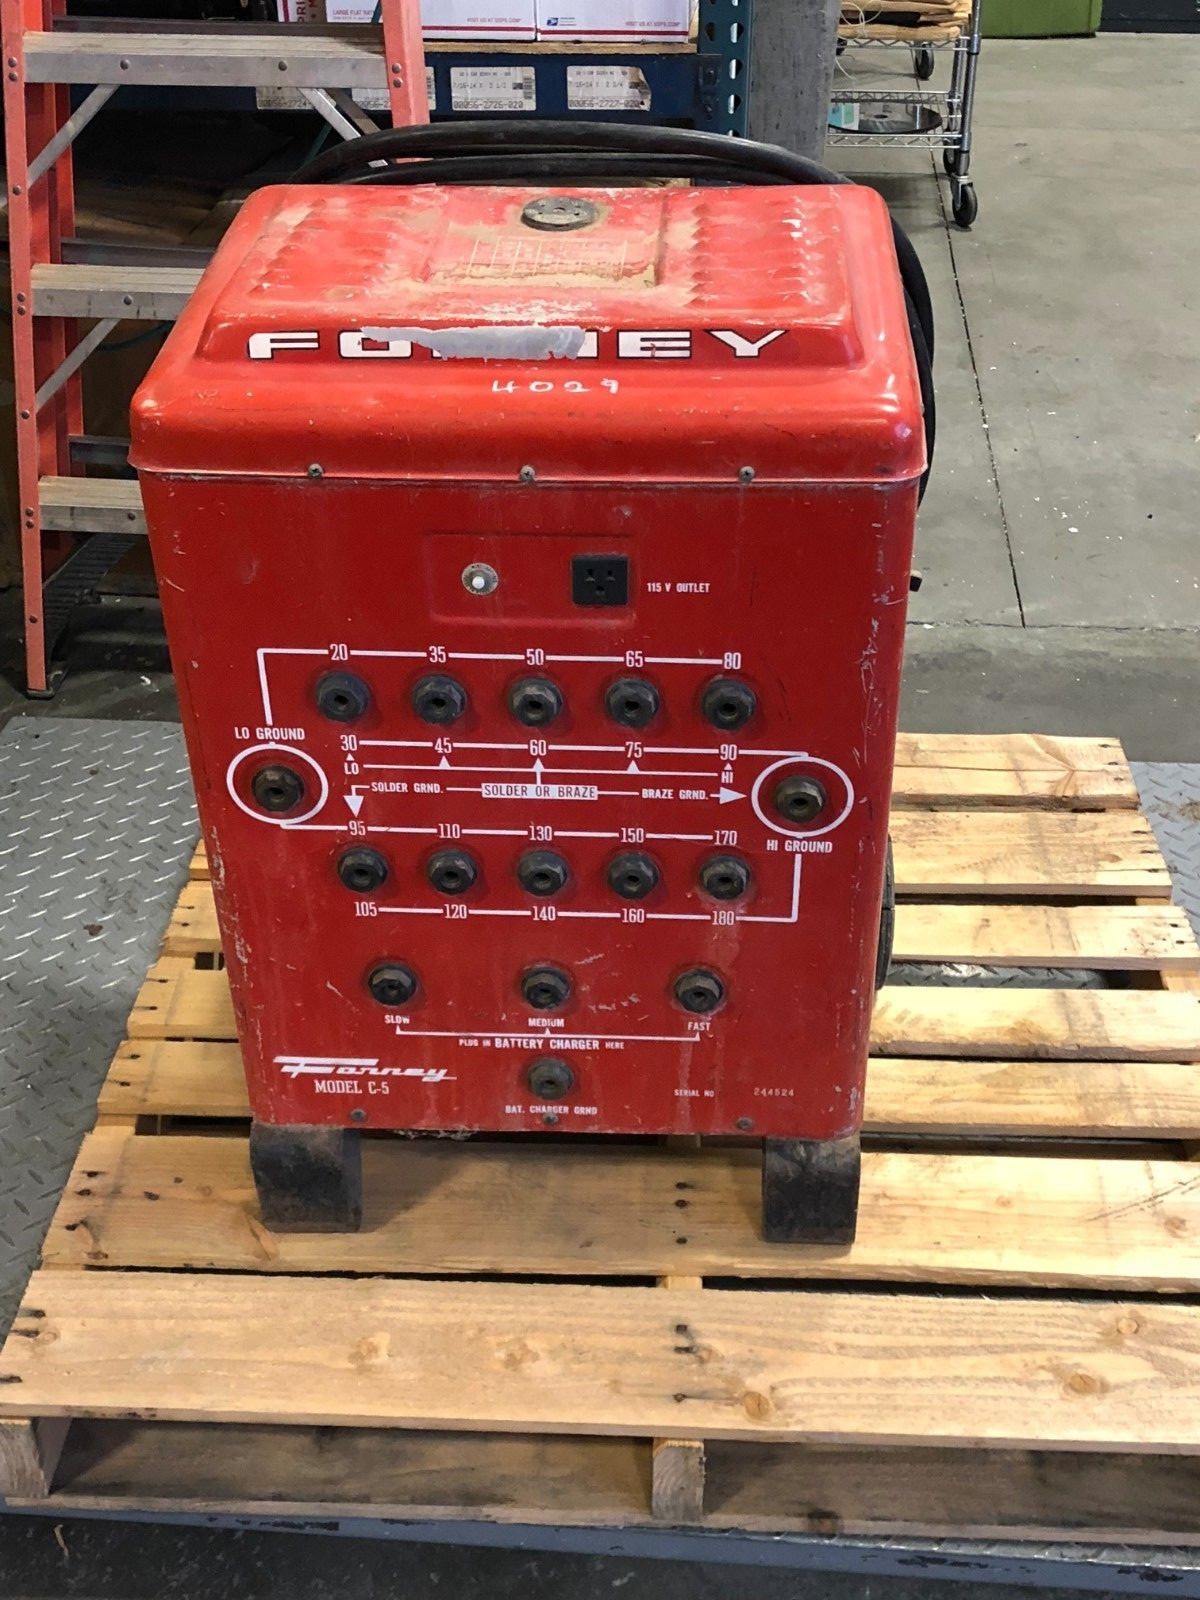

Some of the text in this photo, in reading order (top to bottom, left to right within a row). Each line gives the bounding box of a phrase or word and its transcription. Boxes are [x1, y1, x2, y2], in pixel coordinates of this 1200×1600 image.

[646, 582, 711, 594] 115 V OUTLET
[329, 643, 742, 670] 20 35 50 65 80
[234, 726, 306, 742] LO GROUND
[340, 735, 737, 761] 30 45 60 75 90
[344, 762, 360, 775] LO
[721, 772, 734, 784] HI
[371, 781, 444, 794] SOLDER GRND.
[484, 784, 596, 798] SOLDER OR BRAZE
[642, 788, 708, 800] BRAZE GRND.
[348, 820, 738, 847] 95 110 130 150 170
[766, 839, 833, 854] HI GROUND
[354, 901, 735, 926] 105 120 140 160 180
[384, 1014, 410, 1026] SLOW
[528, 1017, 565, 1029] MEDIUM
[687, 1021, 711, 1032] FAST
[458, 1037, 625, 1051] PLUG IN BATTERY CHARGER HERE
[273, 1055, 458, 1080] Forney
[314, 1080, 390, 1095] MODEL C-5
[674, 1088, 700, 1098] SERIAL
[703, 1089, 715, 1099] NO
[505, 1104, 599, 1116] BAT. CHARGER GRND
